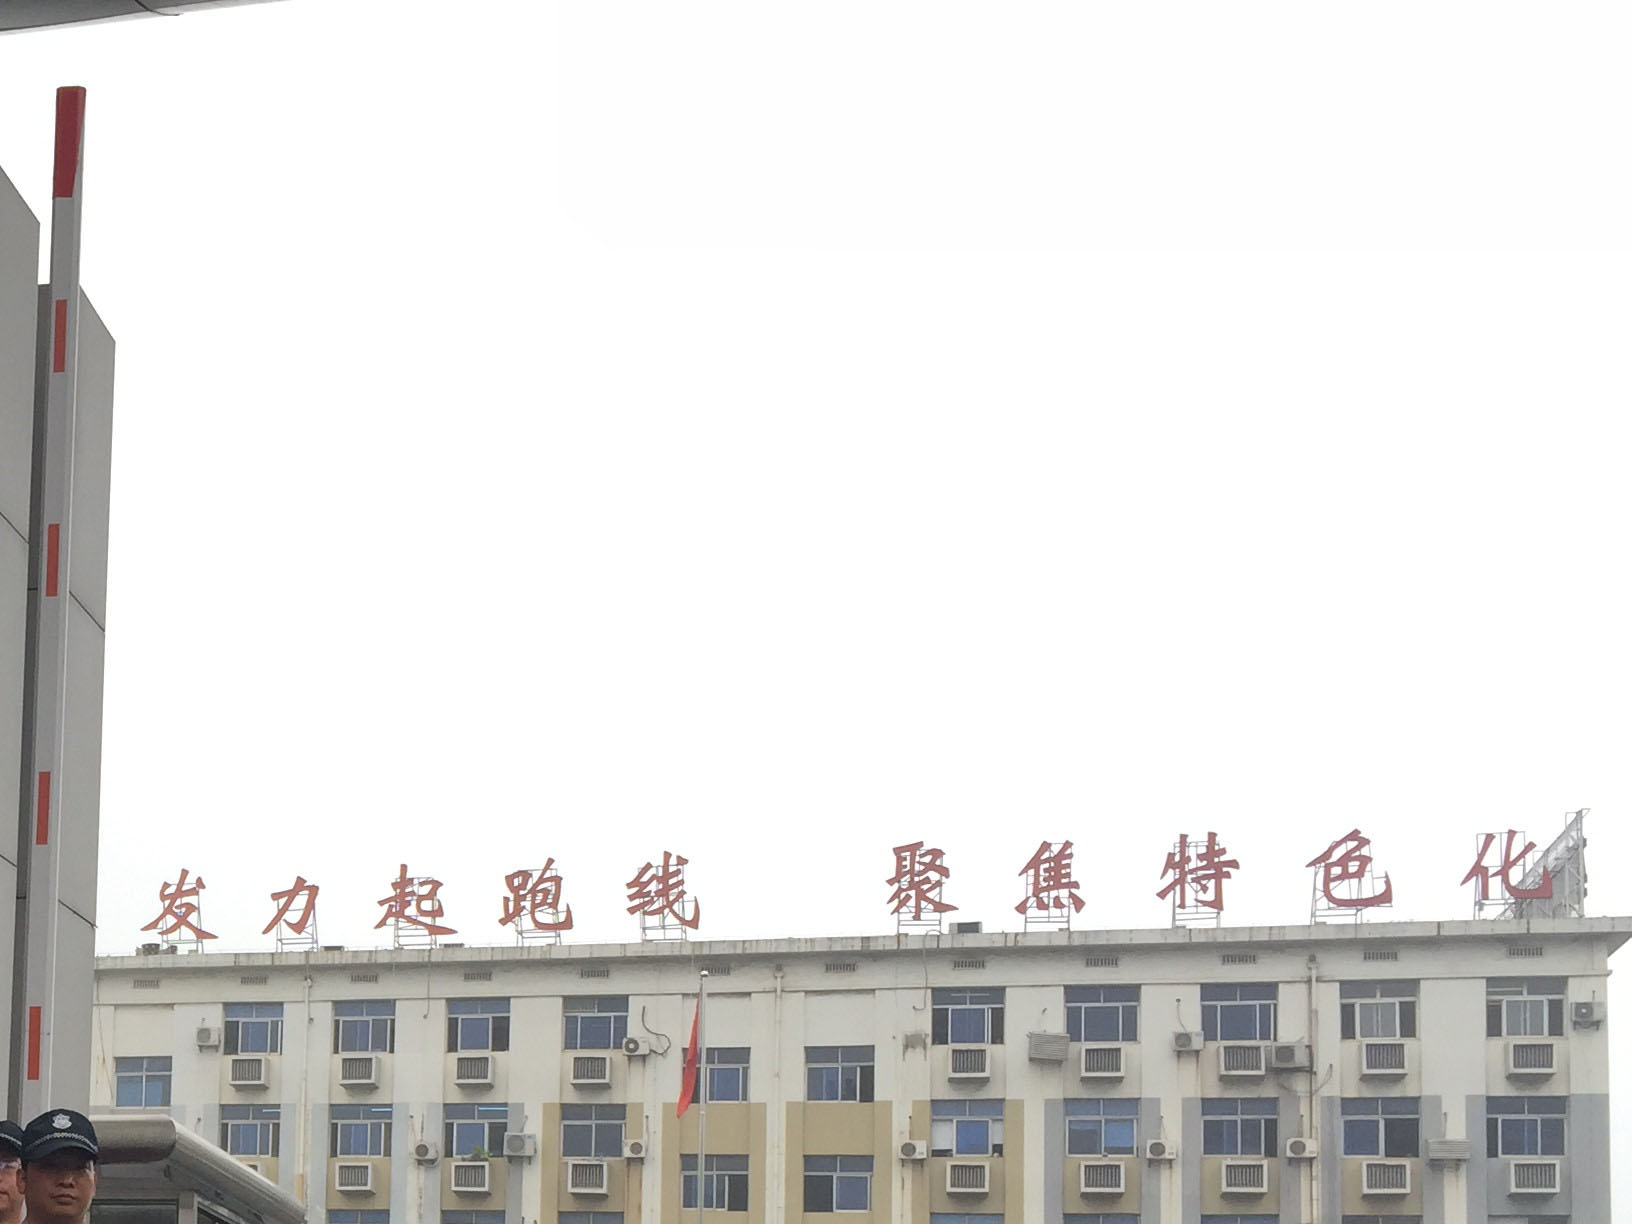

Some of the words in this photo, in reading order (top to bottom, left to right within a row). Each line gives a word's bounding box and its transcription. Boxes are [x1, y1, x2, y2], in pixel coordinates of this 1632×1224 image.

[140, 851, 701, 940] 发力起跑线
[885, 828, 1555, 921] 聚焦特色化
